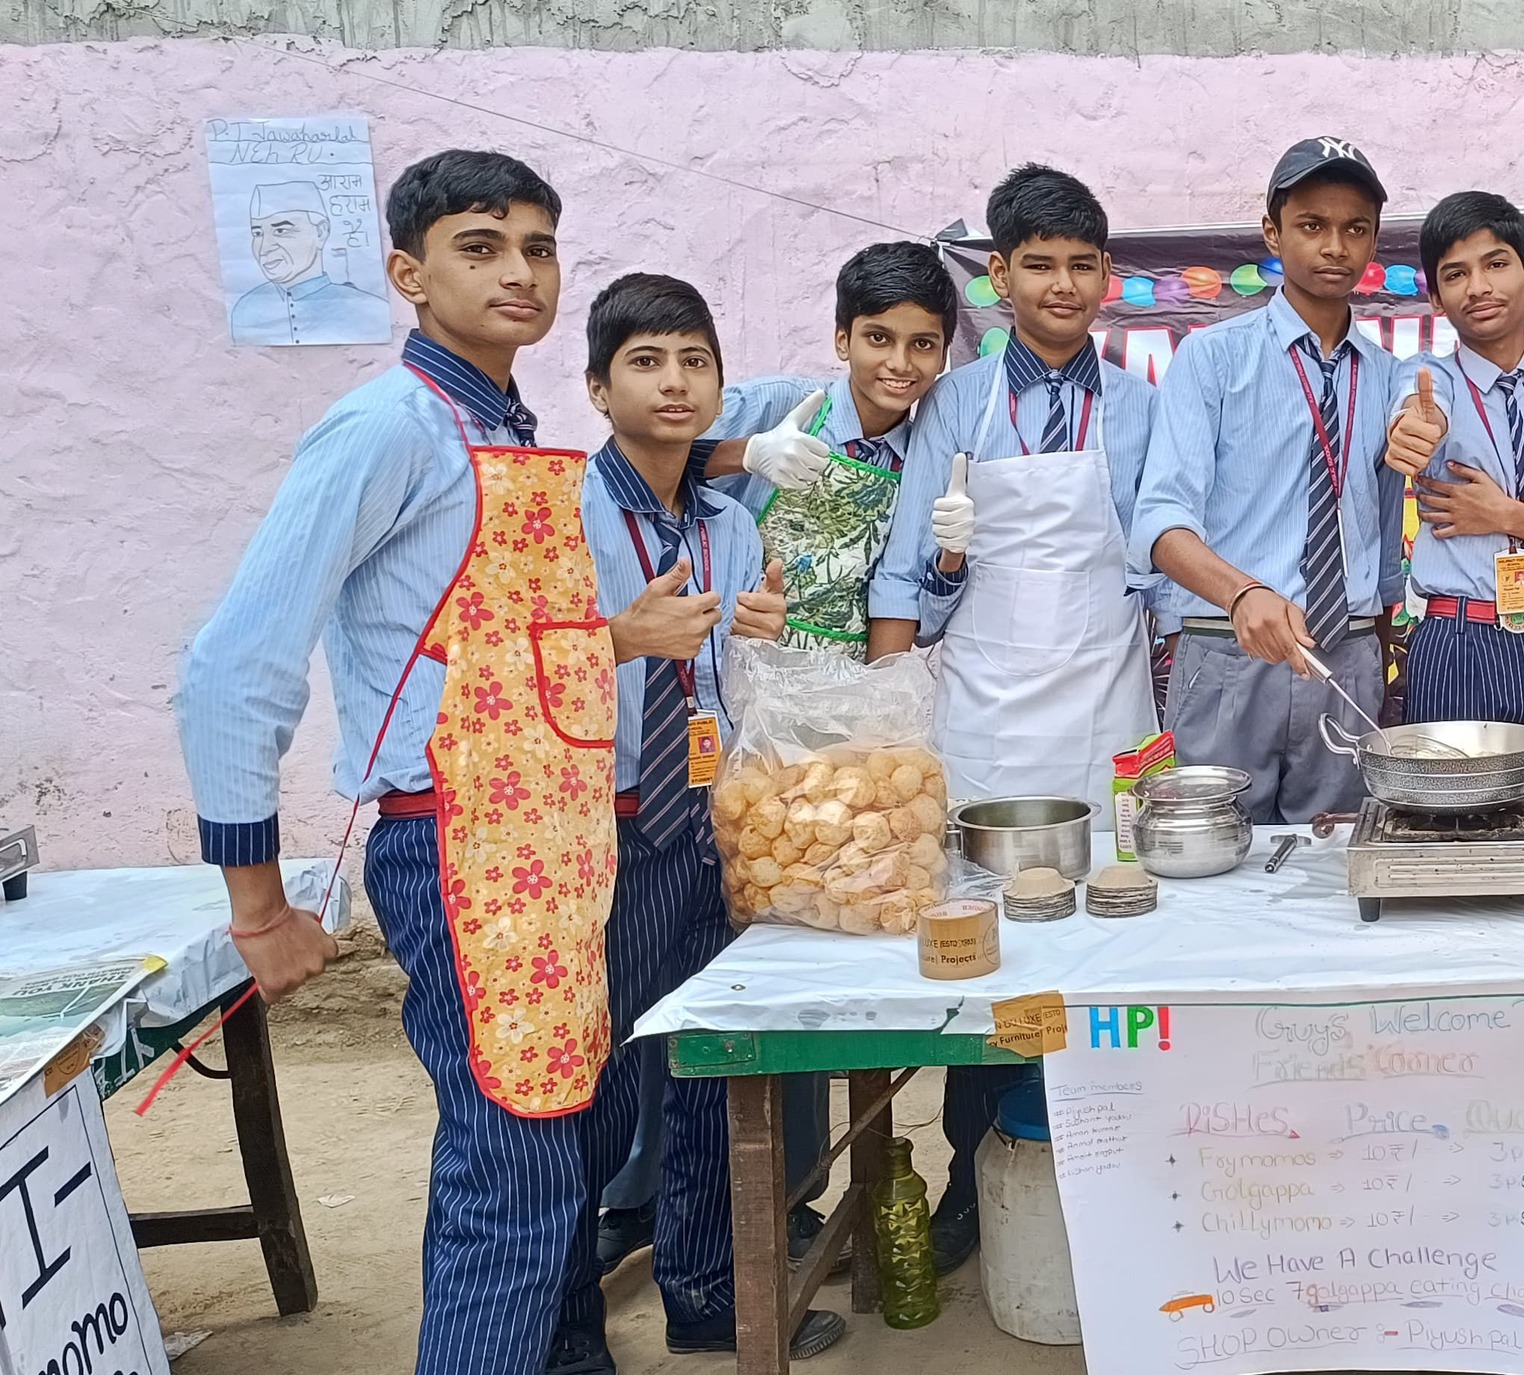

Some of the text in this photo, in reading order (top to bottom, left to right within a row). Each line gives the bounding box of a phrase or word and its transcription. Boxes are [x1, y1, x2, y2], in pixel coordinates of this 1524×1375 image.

[941, 954, 977, 965] Projects
[12, 976, 125, 996] THANK YOU
[1088, 1005, 1171, 1051] HP!
[1255, 1004, 1349, 1056] Guys
[1369, 1001, 1511, 1035] Welcome
[1213, 1246, 1498, 1284] We Have A Challenge
[1410, 1276, 1480, 1306] eating
[1406, 1318, 1484, 1350] Piyush
